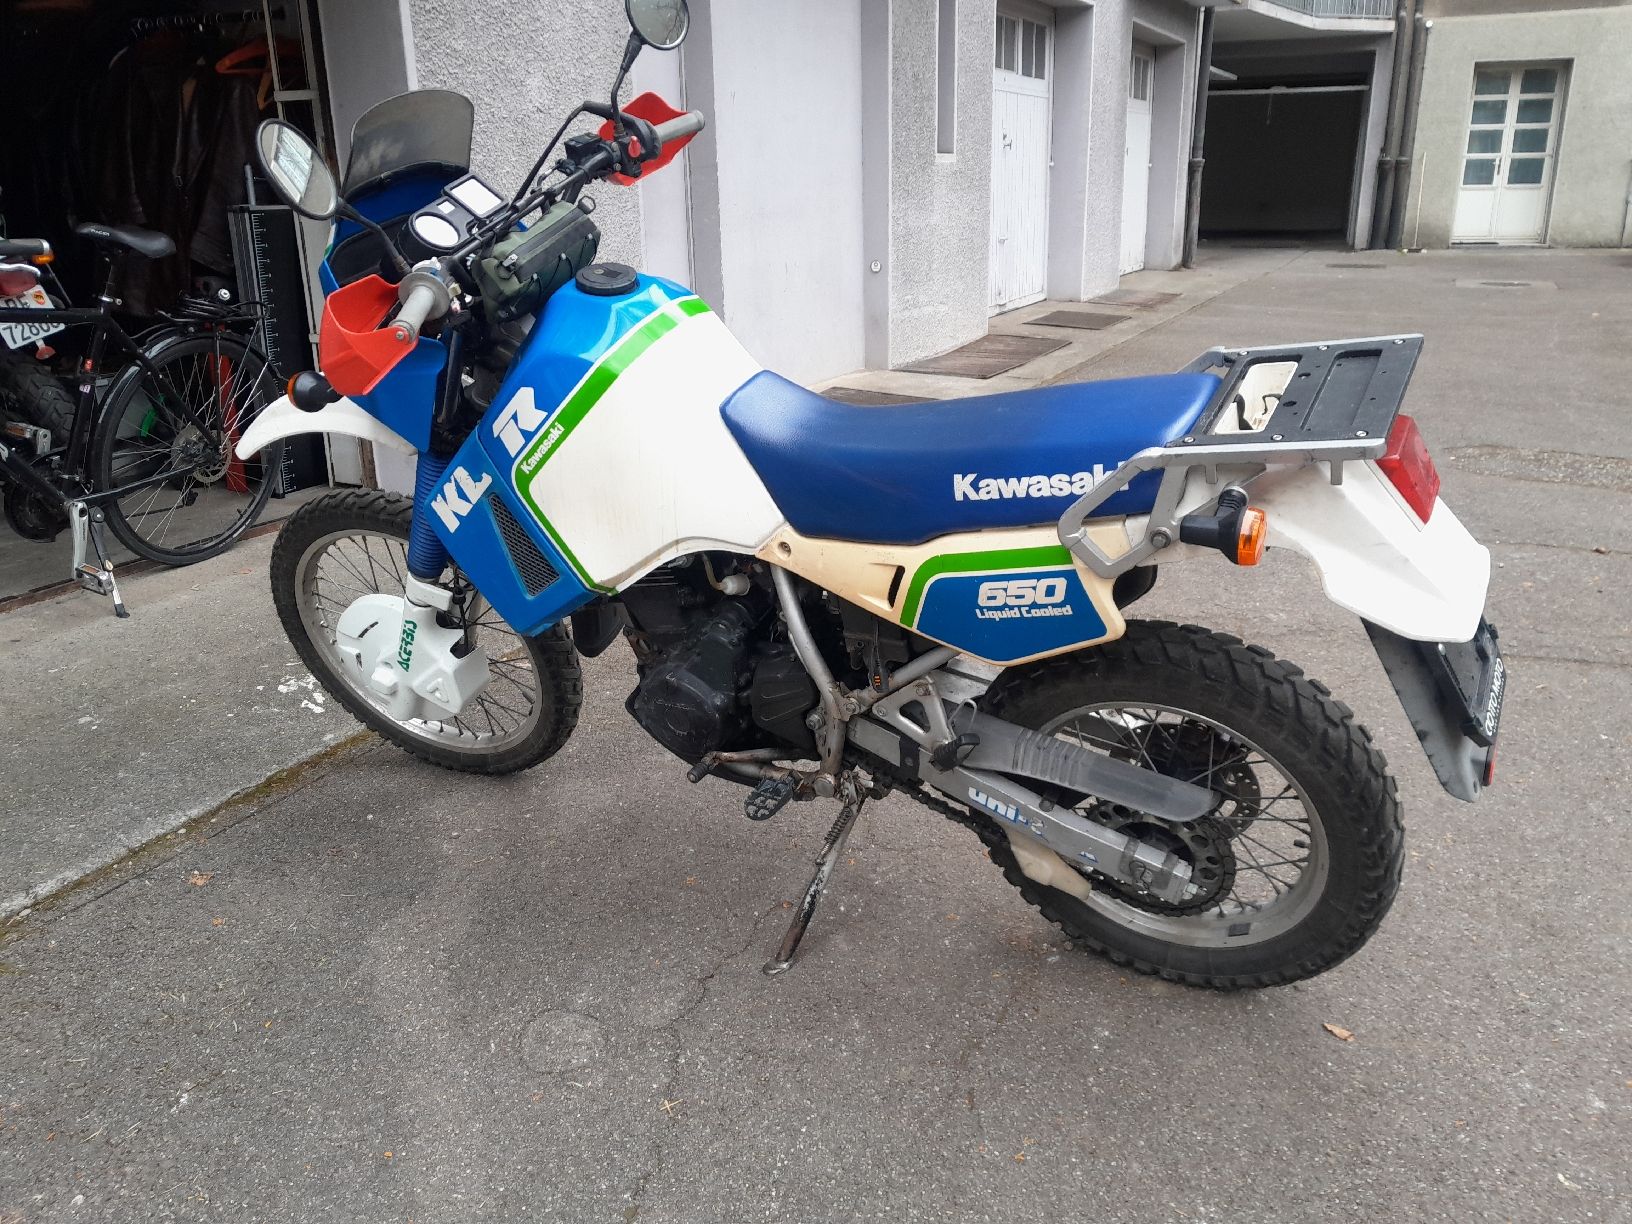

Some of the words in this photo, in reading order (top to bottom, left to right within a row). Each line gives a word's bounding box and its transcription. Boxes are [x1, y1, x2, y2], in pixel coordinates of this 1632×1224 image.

[520, 422, 565, 474] Kawasaki
[977, 577, 1068, 607] 650
[975, 607, 1021, 621] Liquid
[1020, 604, 1073, 618] Cooled
